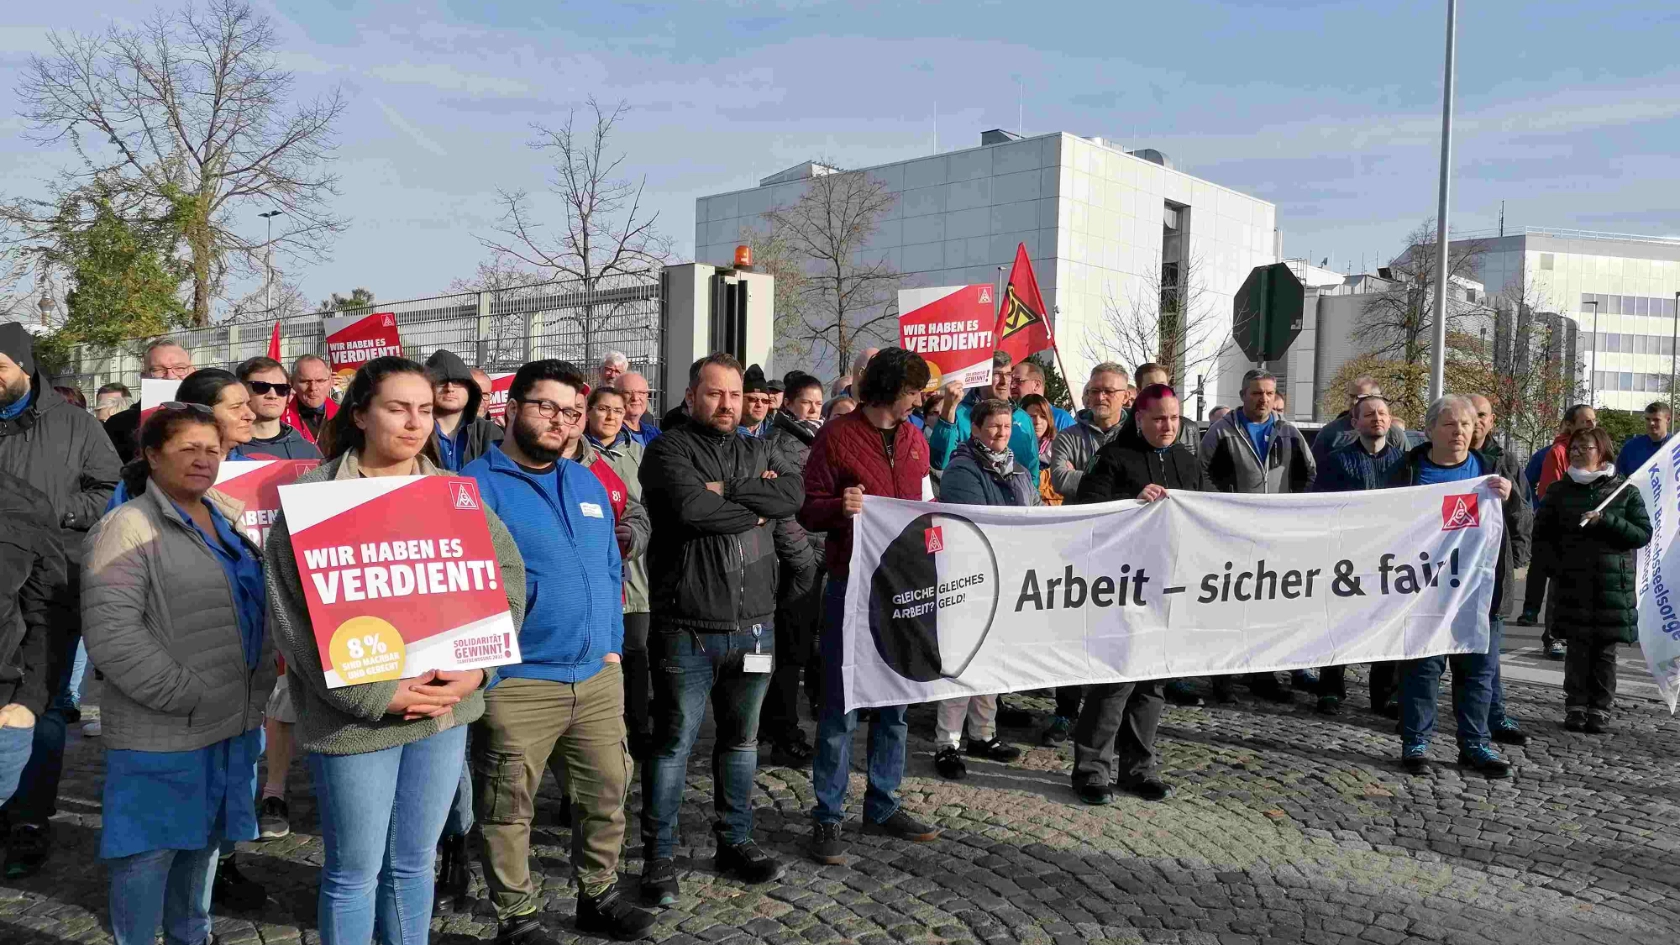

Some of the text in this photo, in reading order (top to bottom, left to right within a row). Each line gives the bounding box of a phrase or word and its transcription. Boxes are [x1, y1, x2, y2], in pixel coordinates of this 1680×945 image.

[903, 320, 979, 336] WIR HABEN ES
[330, 338, 386, 351] WIR HABEN ES
[904, 330, 992, 354] VERDIENT!
[1648, 462, 1662, 508] Kath.
[304, 538, 464, 570] WIR HABEN ES
[311, 560, 498, 605] VERDIENT!
[938, 574, 984, 594] GLEICHES
[1014, 564, 1150, 612] Arbeit
[1197, 560, 1321, 604] sicher
[1331, 558, 1366, 598] &
[1378, 547, 1460, 596] fair!
[892, 586, 935, 605] GLEICHE
[938, 593, 966, 609] GELD!
[892, 602, 935, 620] ARBEIT?
[454, 634, 502, 648] SOLIDARITÄT
